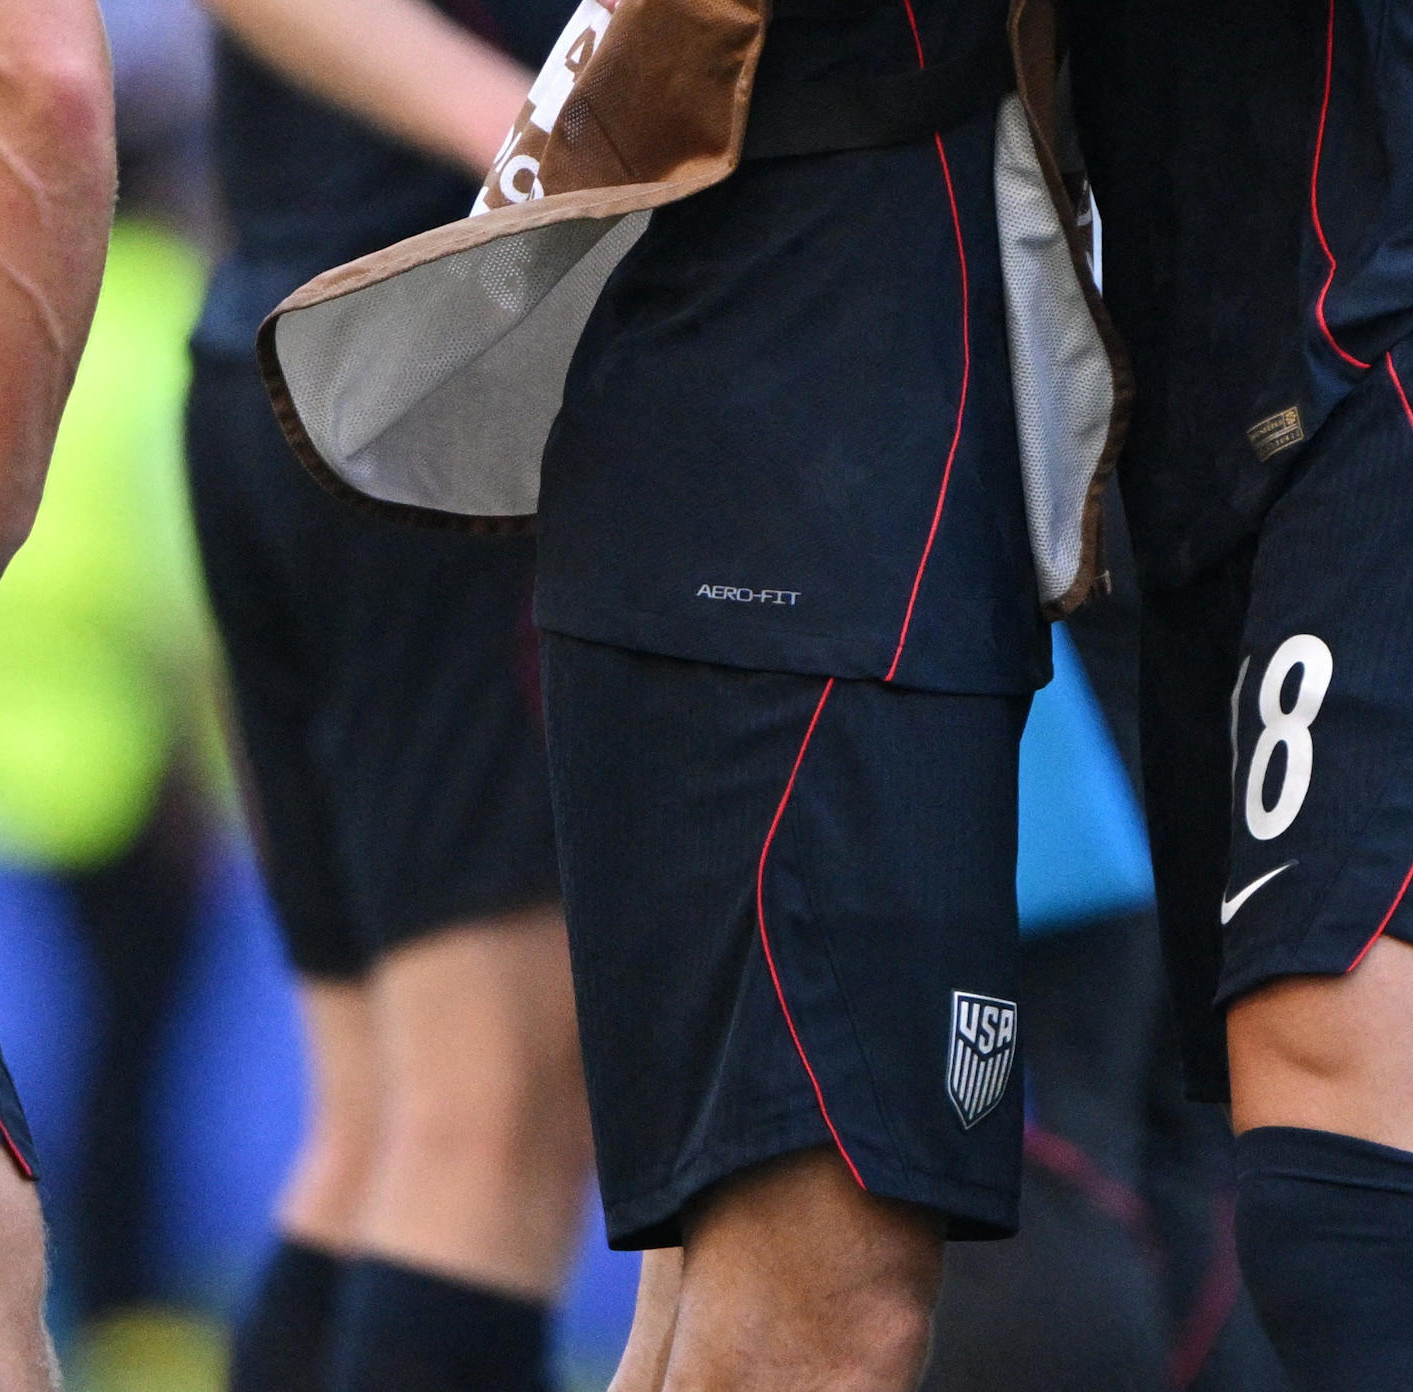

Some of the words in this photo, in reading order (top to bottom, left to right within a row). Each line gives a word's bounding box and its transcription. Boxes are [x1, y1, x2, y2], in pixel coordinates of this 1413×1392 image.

[696, 584, 802, 606] AERO-FIT
[1231, 633, 1333, 841] 8
[959, 1001, 1014, 1054] USA
